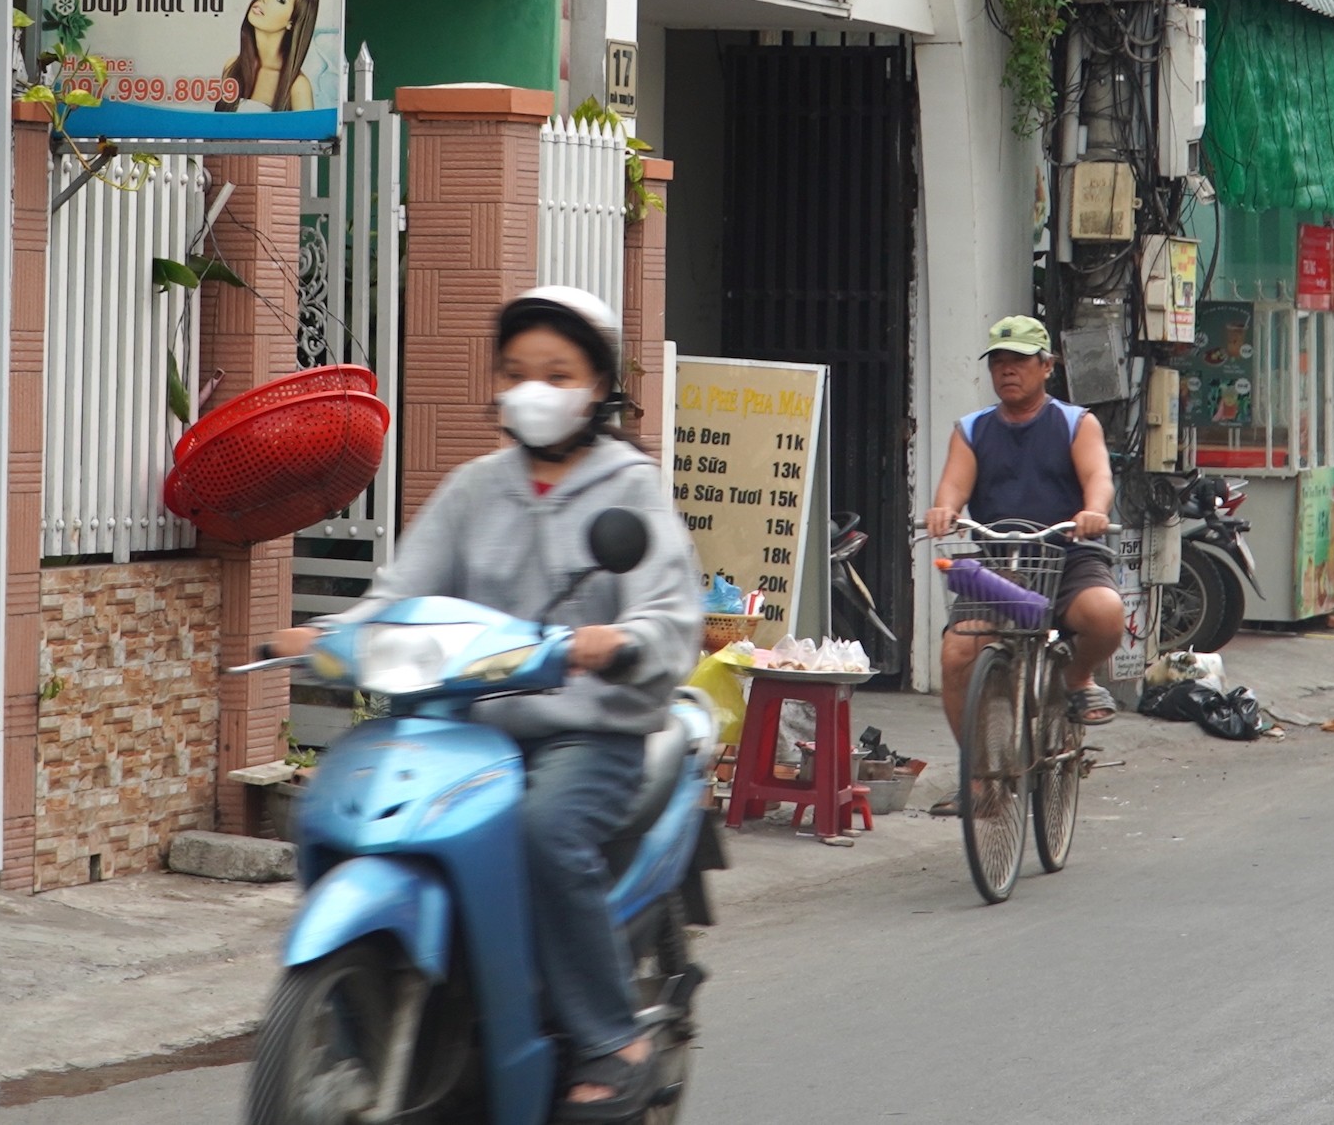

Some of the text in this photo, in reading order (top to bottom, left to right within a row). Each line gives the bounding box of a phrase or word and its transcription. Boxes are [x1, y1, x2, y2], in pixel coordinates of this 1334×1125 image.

[613, 49, 633, 88] 17
[700, 426, 805, 451] Đen 11k
[698, 454, 801, 479] Sữa 13k
[694, 483, 798, 508] Sữa Tươi 15k
[766, 517, 794, 536] 15k
[762, 547, 791, 565] 18k
[758, 575, 787, 594] 20k
